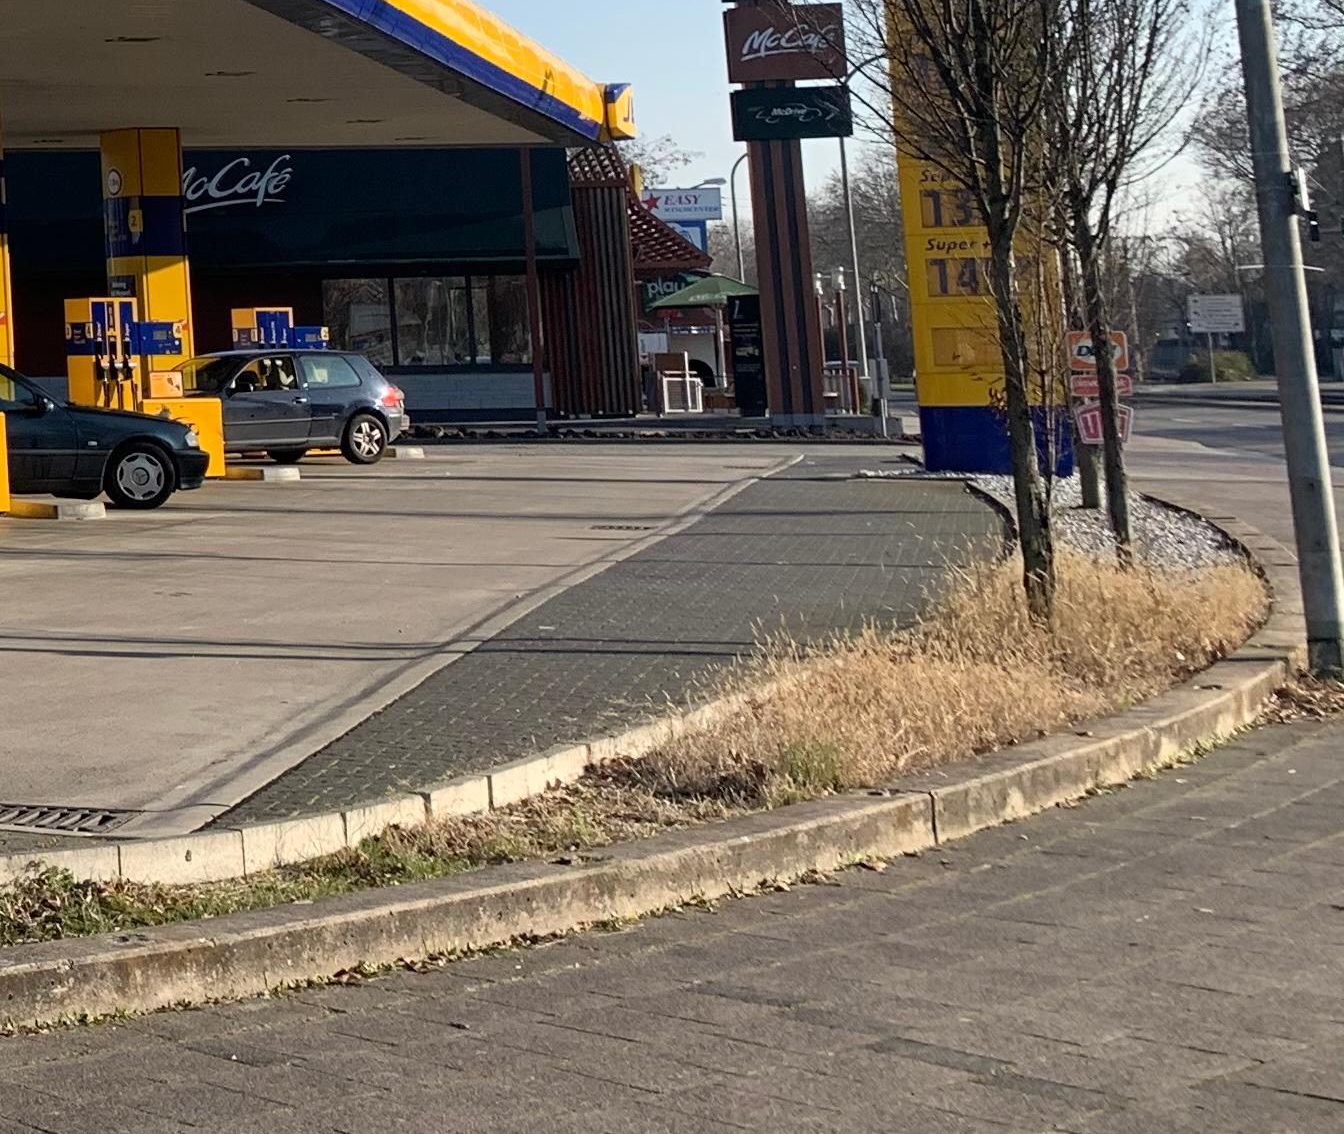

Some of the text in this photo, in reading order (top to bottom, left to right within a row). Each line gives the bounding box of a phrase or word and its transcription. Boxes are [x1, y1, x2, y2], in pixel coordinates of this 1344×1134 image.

[664, 195, 701, 206] EASY
[130, 215, 137, 227] 2
[925, 238, 977, 254] Super
